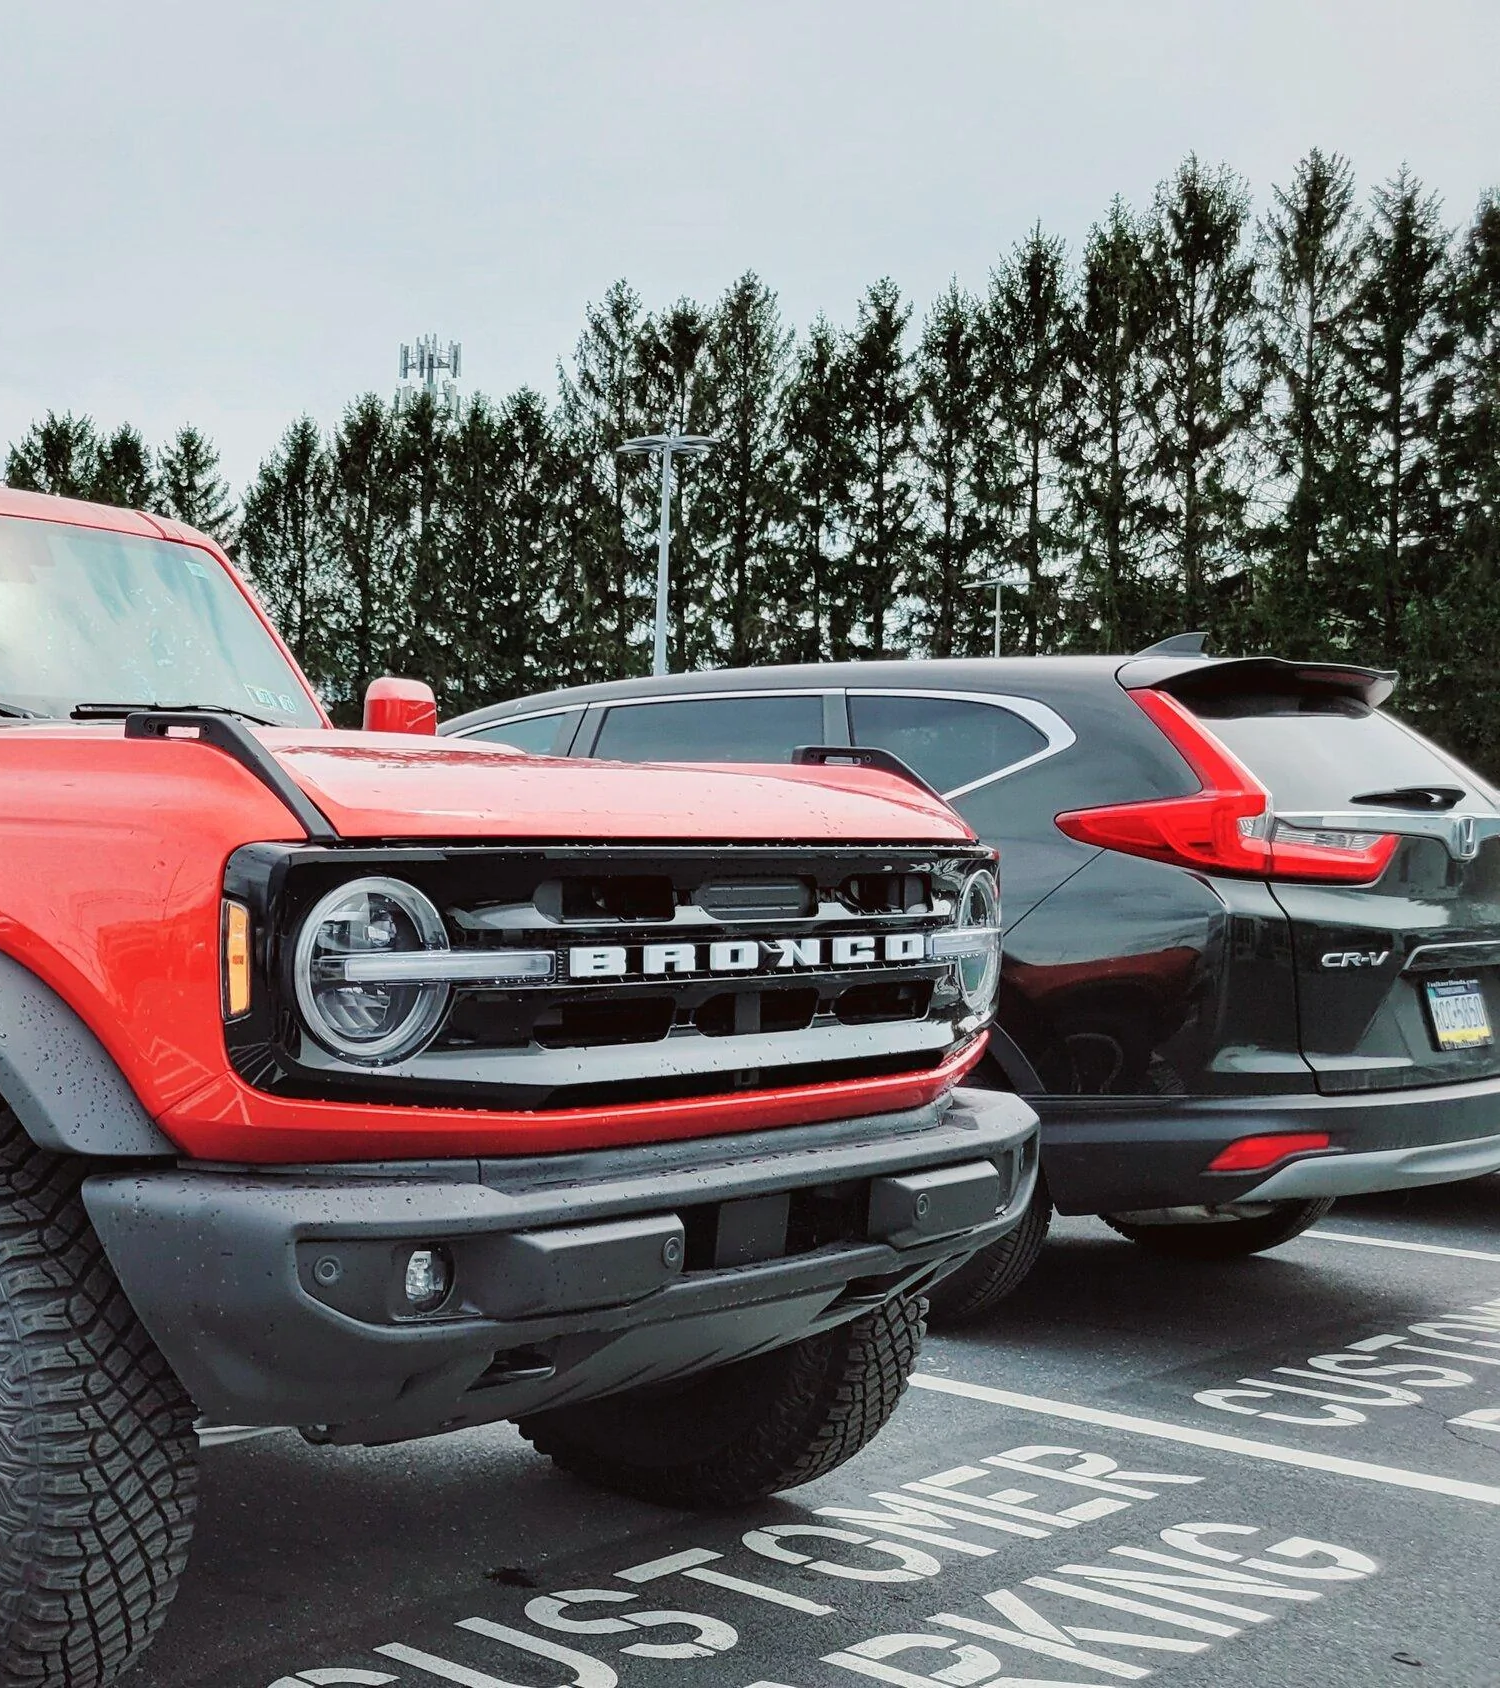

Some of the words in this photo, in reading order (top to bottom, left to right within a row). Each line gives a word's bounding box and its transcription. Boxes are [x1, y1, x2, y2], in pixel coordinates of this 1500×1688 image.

[569, 933, 926, 978] BRONCO
[1321, 951, 1389, 968] CR-V
[266, 1445, 1206, 1688] USTOMER
